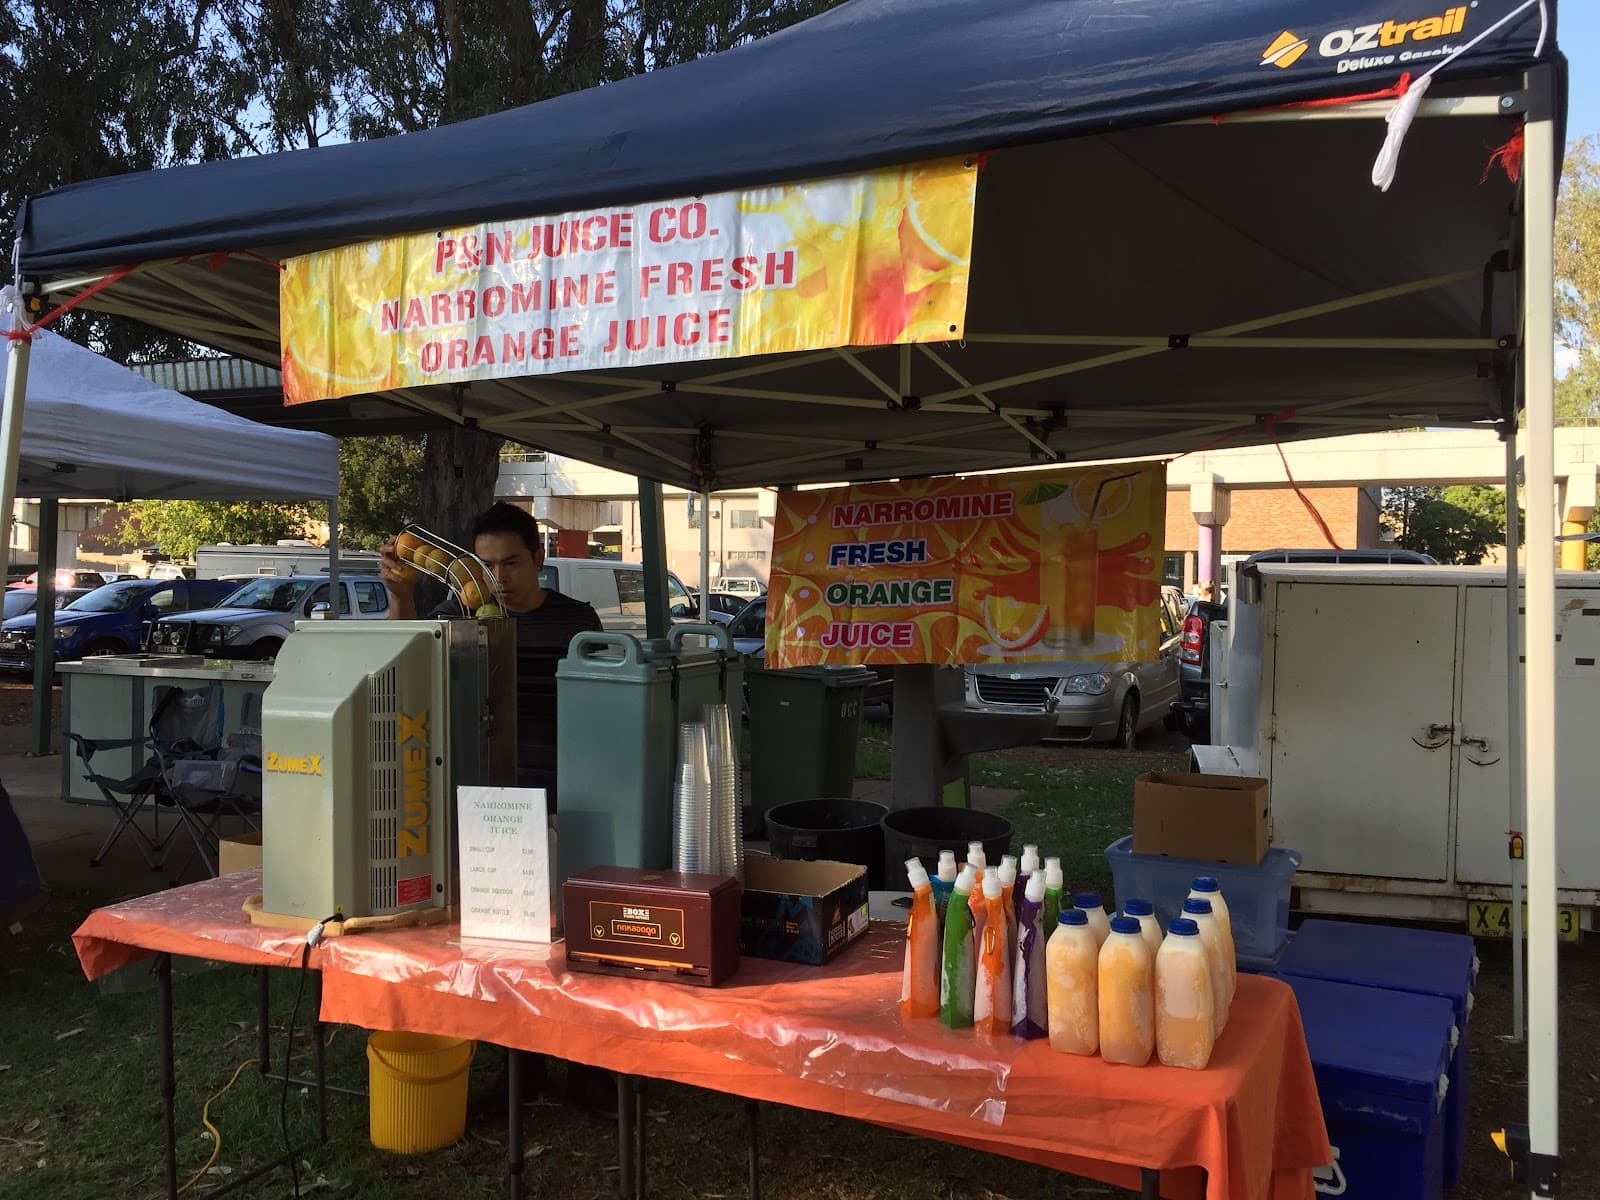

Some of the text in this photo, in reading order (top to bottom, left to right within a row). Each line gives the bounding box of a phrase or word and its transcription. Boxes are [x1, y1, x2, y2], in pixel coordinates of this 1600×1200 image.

[1318, 6, 1467, 57] OZtrail
[1337, 55, 1394, 74] Deluxe
[436, 202, 720, 273] P&N JUICE CO.
[380, 251, 795, 333] NARROMINE FRESH
[421, 309, 731, 372] ORANGE JUICE
[832, 492, 1013, 528] NARROMINE
[829, 540, 927, 567] FRESH
[826, 579, 954, 606] ORANGE
[821, 623, 914, 648] JUICE
[473, 801, 533, 811] NARROMINE
[482, 815, 523, 824] ORANGE
[489, 826, 518, 835] JUICE
